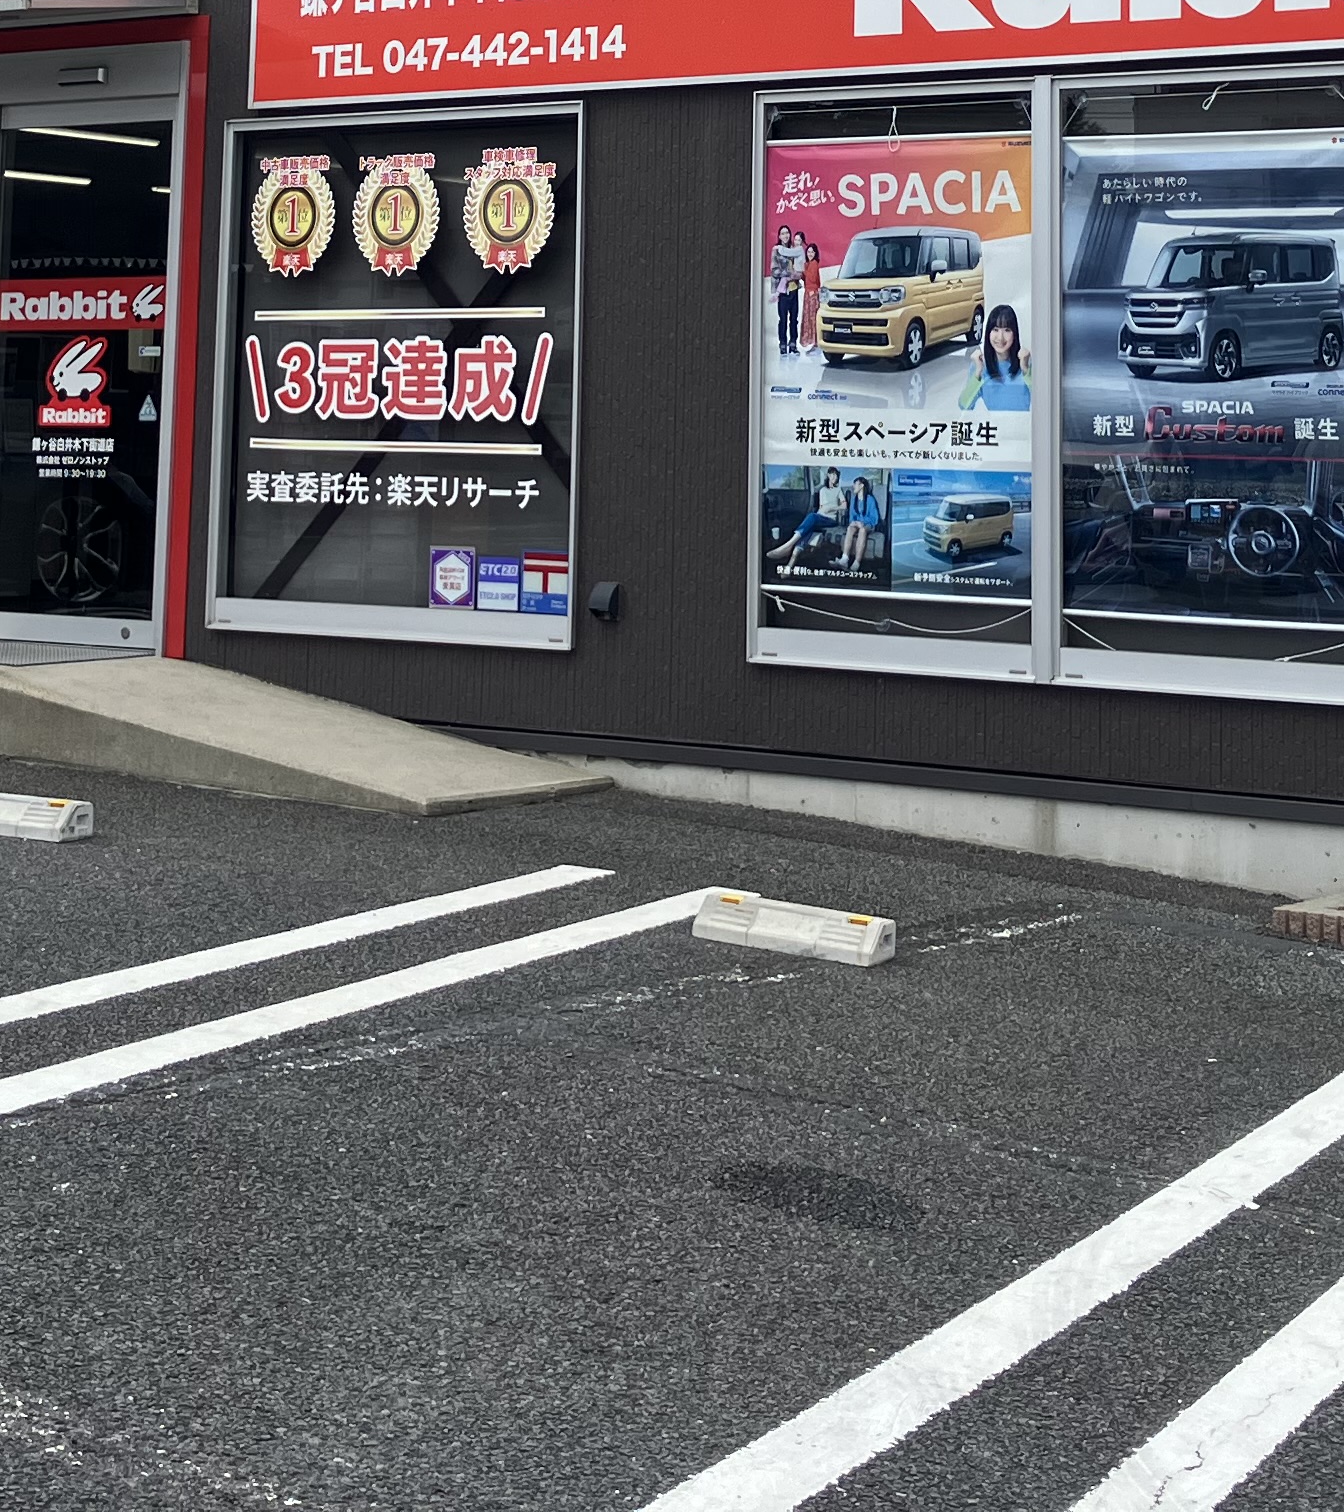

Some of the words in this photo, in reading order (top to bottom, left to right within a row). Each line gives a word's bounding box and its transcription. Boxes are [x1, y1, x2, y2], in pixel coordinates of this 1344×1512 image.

[312, 43, 374, 78] TEL
[383, 24, 627, 74] 047-442-1414
[259, 155, 331, 172] 中古車販売価格
[358, 153, 436, 171] トラック販売価格
[279, 172, 309, 187] 満足度
[380, 171, 410, 187] 満足度
[838, 170, 1022, 218] SPACIA
[0, 290, 128, 321] Rabbit
[274, 336, 516, 422] 3冠達成
[41, 406, 107, 424] Rabbit
[1181, 400, 1255, 415] SPACIA
[795, 416, 1000, 447] 新型スペーシア誕生
[1092, 414, 1135, 437] 新型
[1144, 405, 1286, 444] Custom
[1293, 417, 1340, 441] 誕生
